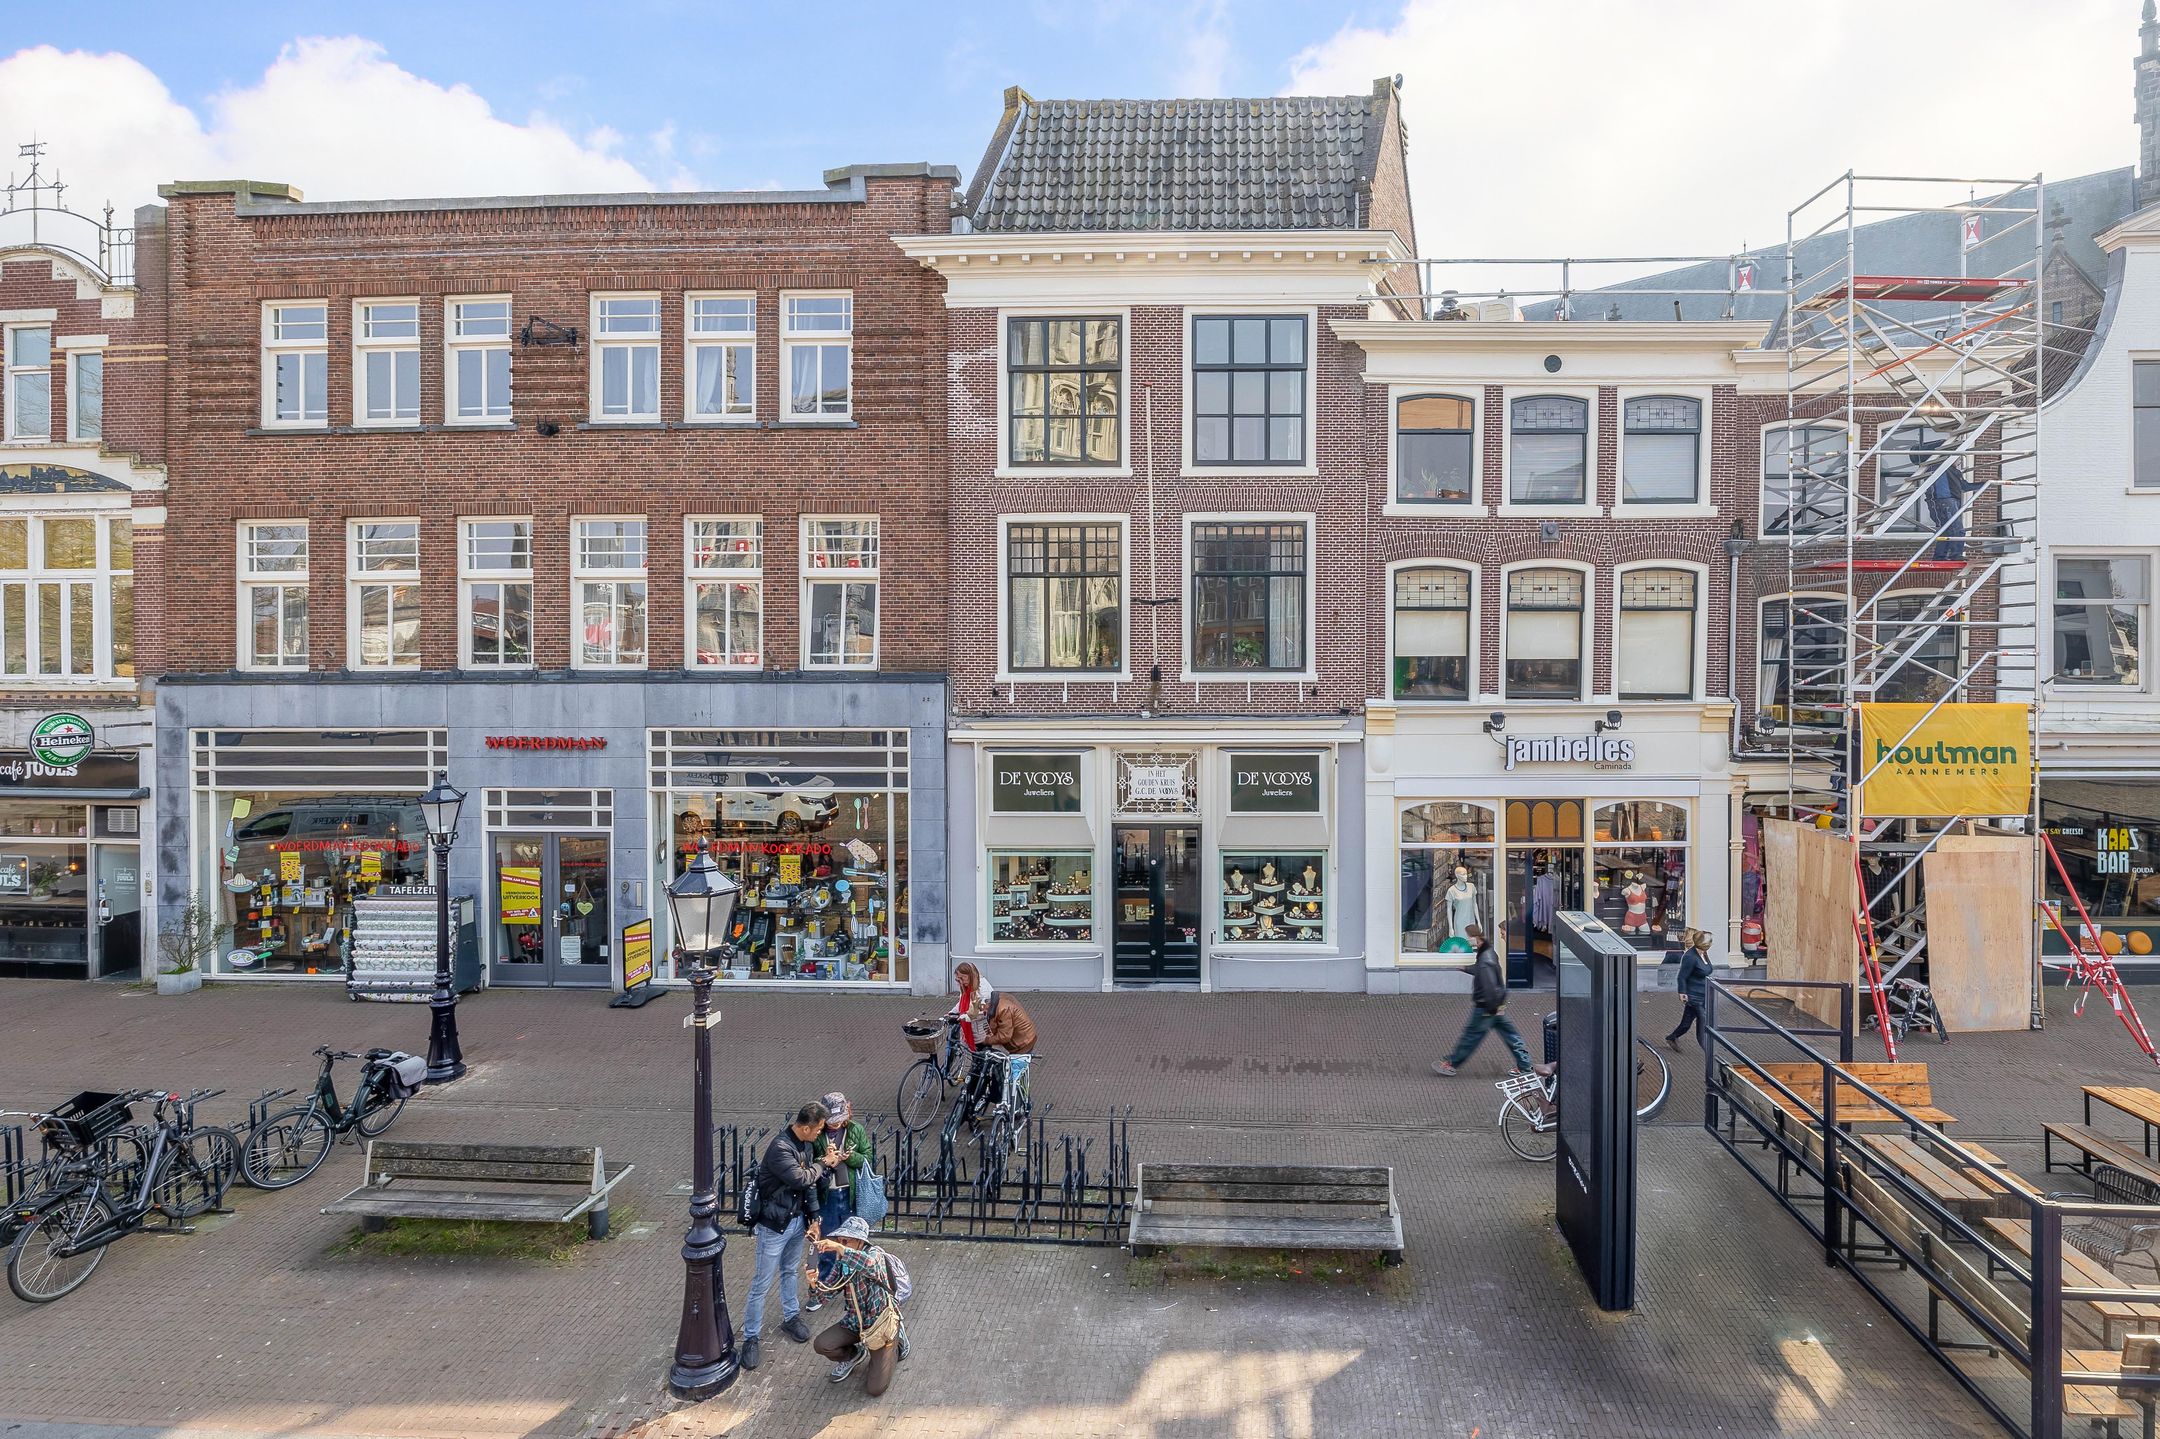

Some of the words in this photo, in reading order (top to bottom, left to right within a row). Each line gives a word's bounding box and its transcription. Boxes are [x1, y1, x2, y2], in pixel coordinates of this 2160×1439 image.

[40, 735, 90, 747] Heineken
[485, 736, 608, 751] WOERDMAN
[1504, 735, 1635, 771] jambelles
[1876, 739, 2017, 764] houtman
[0, 760, 24, 781] café
[1594, 762, 1632, 770] Caminada
[999, 771, 1021, 785] DE
[1024, 771, 1074, 785] VOOYS
[1137, 778, 1159, 786] GOUDEN
[1160, 778, 1176, 786] KRUIS
[1237, 771, 1259, 786] DE
[1262, 771, 1313, 786] VOOYS
[1023, 789, 1055, 797] Juweliers
[1158, 787, 1179, 795] VOOYS
[1261, 789, 1293, 797] Juweliers
[276, 840, 350, 852] WOERDMAN
[760, 842, 832, 855] KOOKKADO
[2097, 851, 2129, 873] BAR
[389, 886, 437, 895] TAFELZEIL
[621, 881, 630, 894] 9
